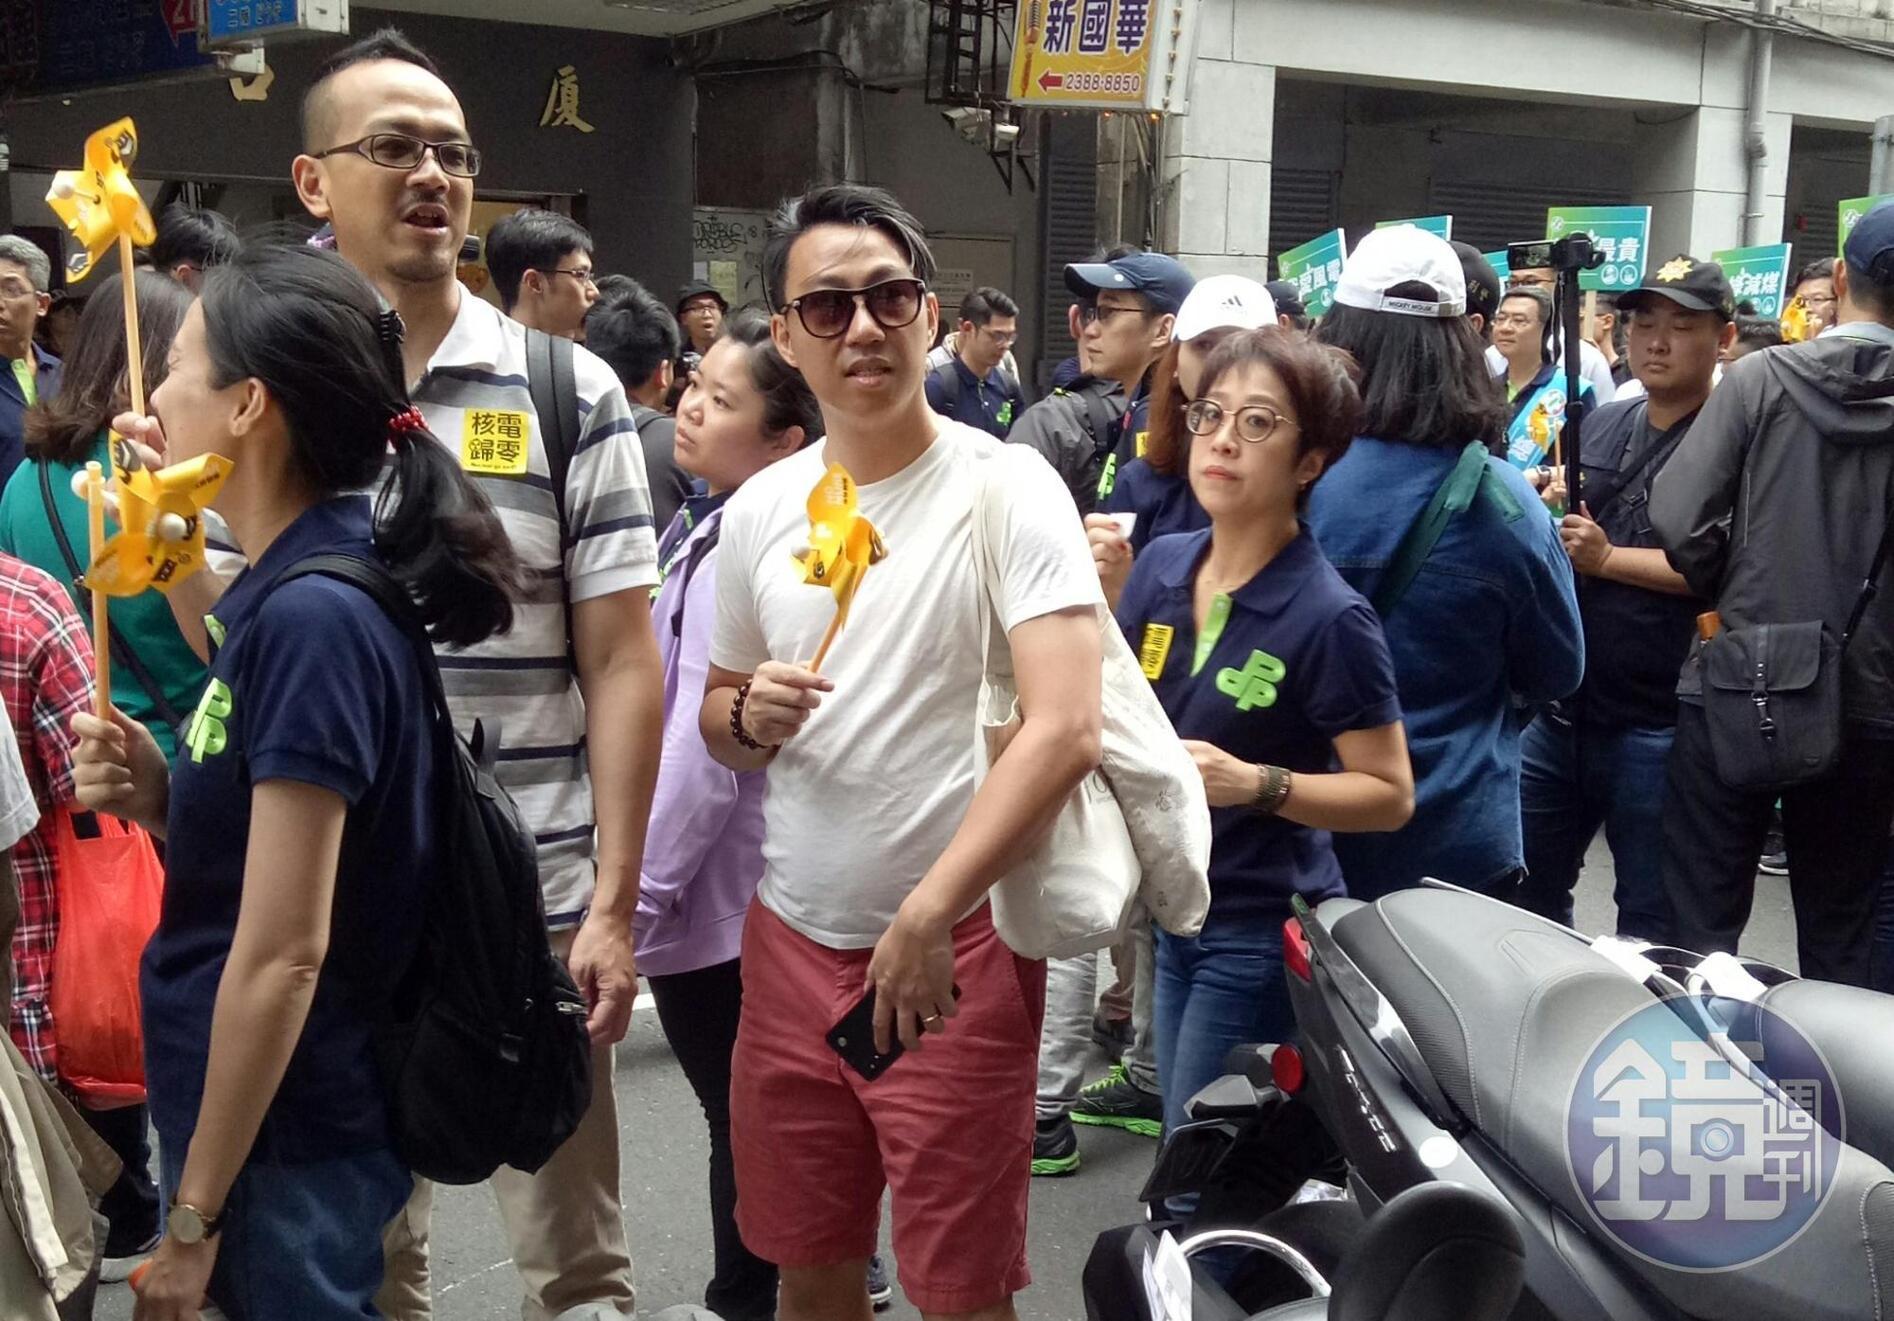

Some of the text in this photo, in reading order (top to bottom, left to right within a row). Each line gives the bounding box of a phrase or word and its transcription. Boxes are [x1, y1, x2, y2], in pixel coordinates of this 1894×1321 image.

[1043, 0, 1149, 54] 新國華
[539, 64, 595, 133] 廈
[471, 412, 522, 439] 核電
[468, 438, 520, 463] 歸零
